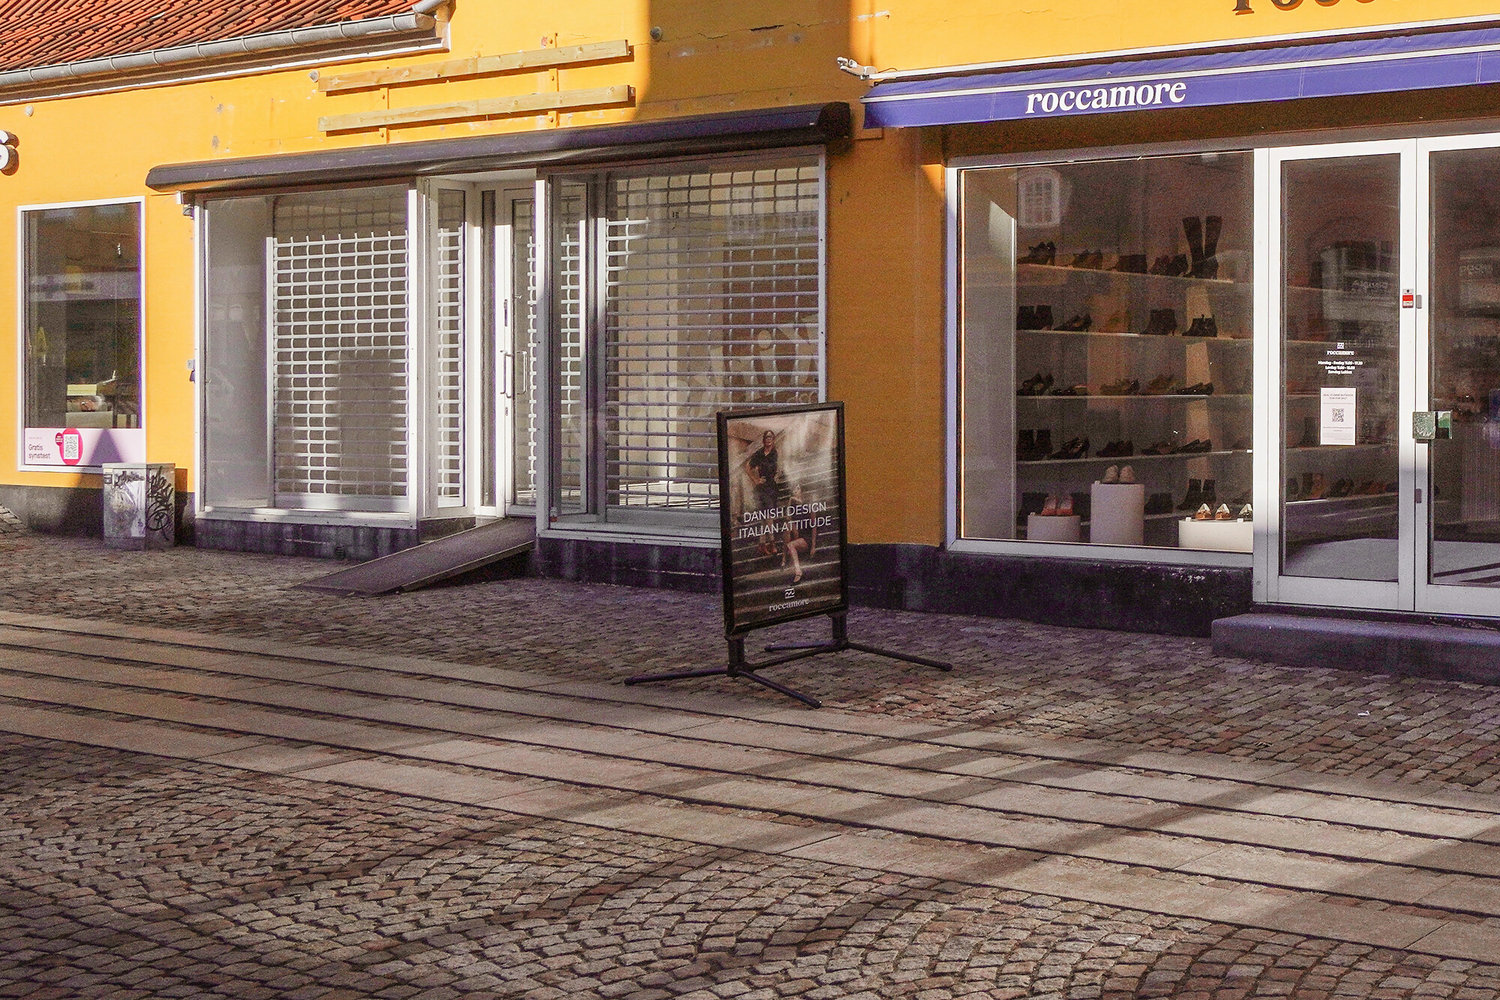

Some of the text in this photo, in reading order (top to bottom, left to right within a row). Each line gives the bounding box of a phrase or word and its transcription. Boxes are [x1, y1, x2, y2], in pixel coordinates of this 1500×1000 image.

[1025, 81, 1187, 114] roccamore
[28, 443, 43, 451] Gratis
[743, 501, 827, 523] DANISH DESIGN
[739, 515, 832, 539] ITALIAN ATTITUDE
[768, 598, 811, 612] roccamore
